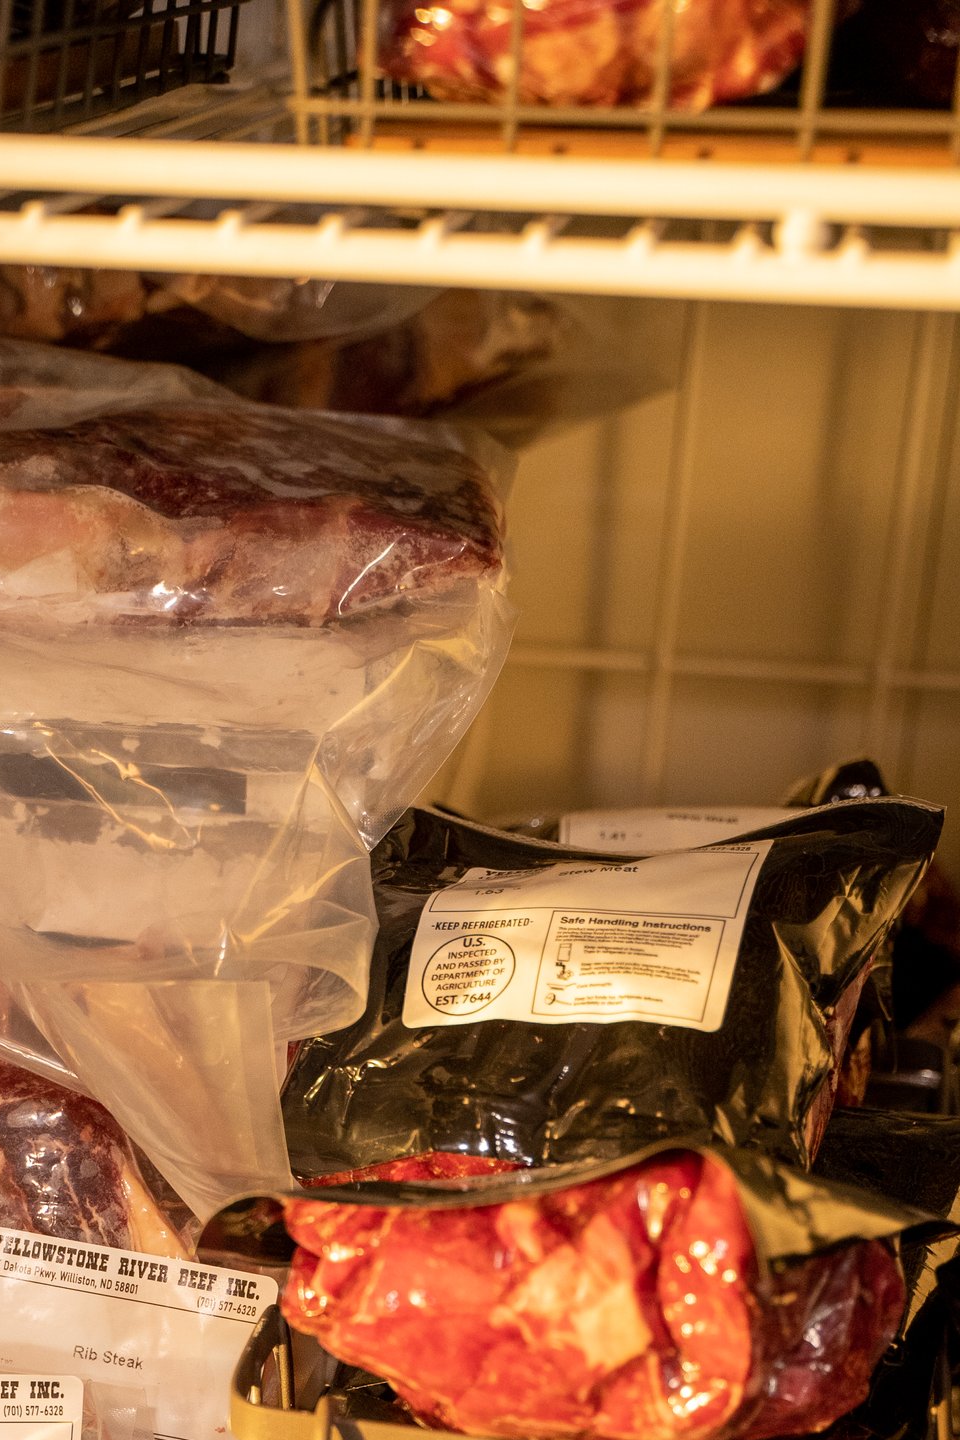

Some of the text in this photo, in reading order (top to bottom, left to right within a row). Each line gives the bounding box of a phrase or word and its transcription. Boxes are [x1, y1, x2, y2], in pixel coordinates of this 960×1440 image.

[560, 916, 713, 933] Safe Handling Instructions
[463, 937, 486, 948] U.S.
[448, 948, 497, 960] INSPECTED
[436, 958, 506, 971] AND PASSED BY
[431, 968, 506, 982] DEPARTMENT OF
[435, 979, 497, 992] AGRICULTURE
[435, 992, 492, 1006] EST. 7644
[3, 1260, 32, 1275] Dakota
[34, 1266, 57, 1282] Pkwy.
[60, 1271, 98, 1289] Williston,
[100, 1279, 113, 1290] ND
[115, 1281, 139, 1295] 58801
[118, 1257, 169, 1283] RIVER
[178, 1268, 218, 1292] BEEF
[226, 1277, 260, 1301] INC.
[197, 1295, 257, 1317] (701) 577-6328
[73, 1345, 144, 1370] Rib Steak
[29, 1381, 65, 1399] INC.
[3, 1405, 64, 1418] (701) 577-6328
